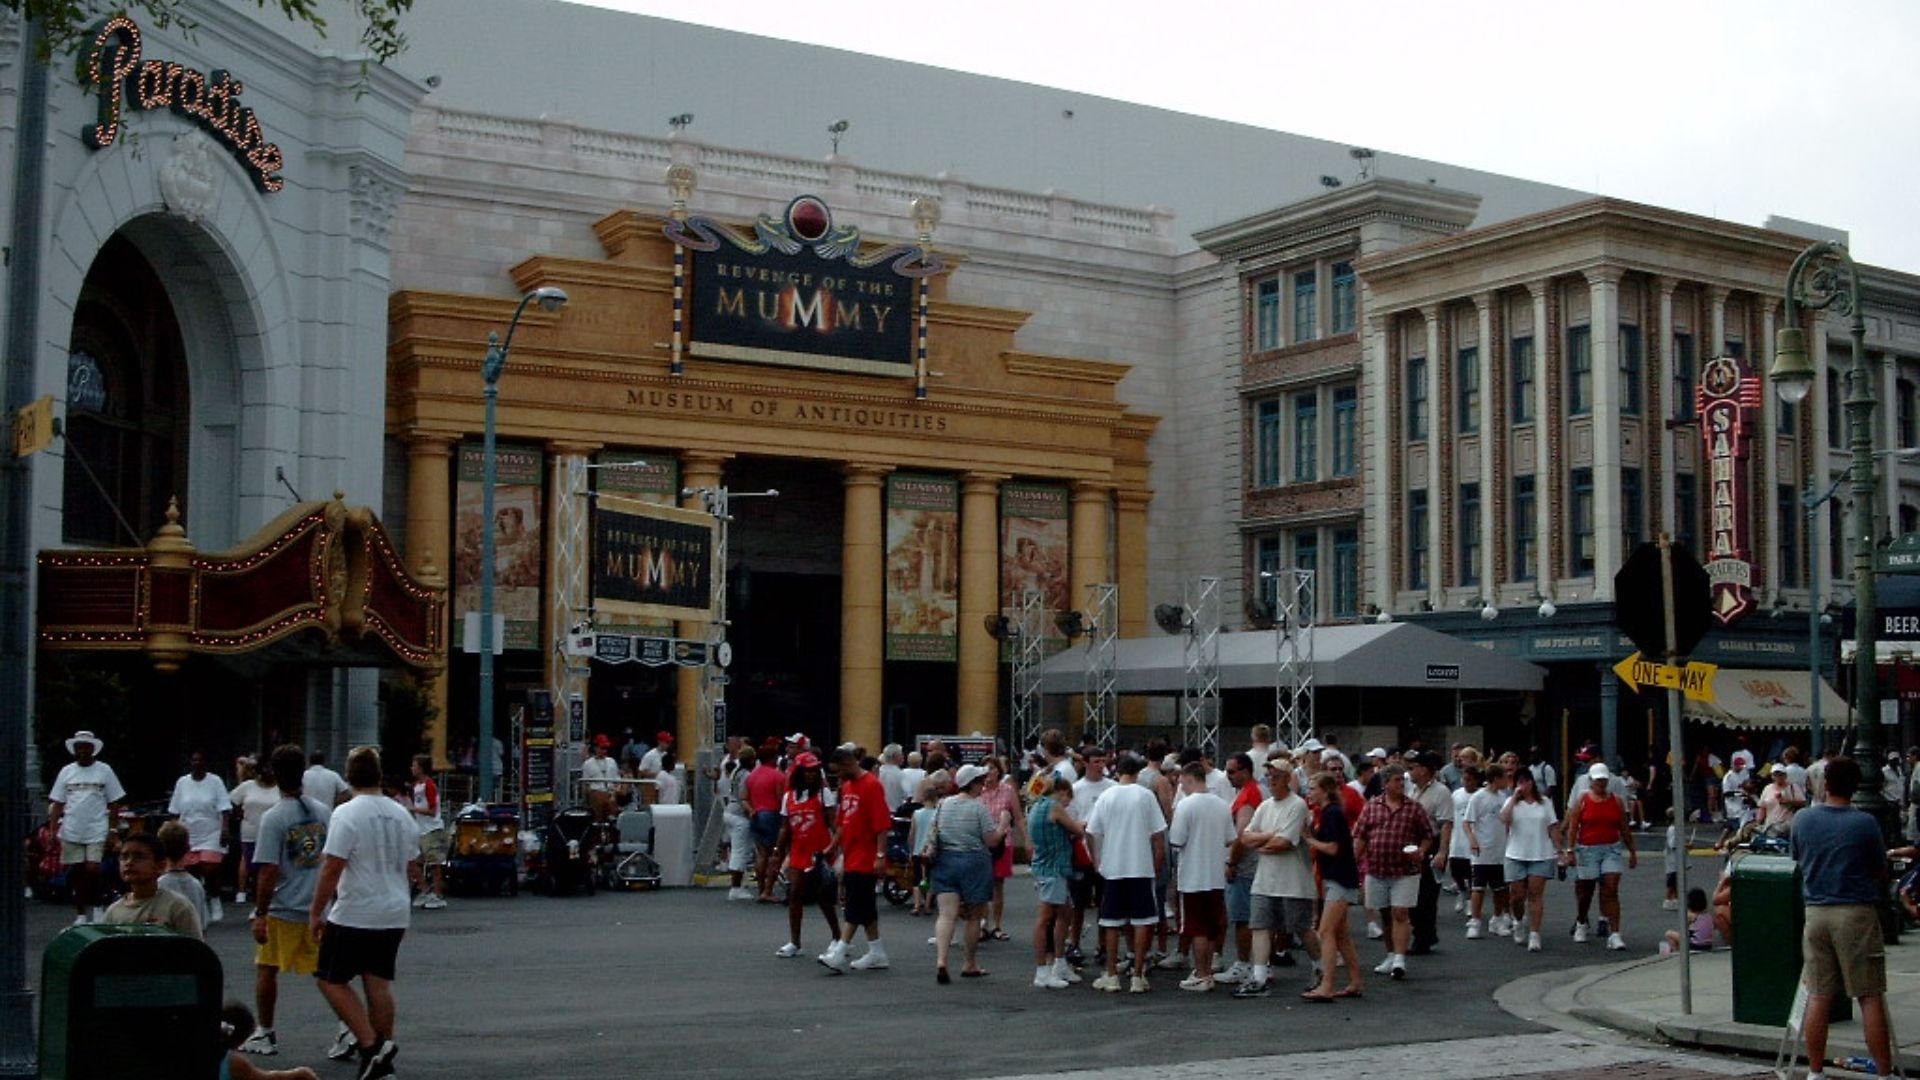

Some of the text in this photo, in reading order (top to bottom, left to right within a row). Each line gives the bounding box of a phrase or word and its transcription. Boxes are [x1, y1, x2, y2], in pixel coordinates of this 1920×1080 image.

[83, 15, 285, 193] Paradise
[717, 263, 894, 296] REVENGE OF THE
[717, 286, 893, 333] MUMMY
[627, 389, 947, 432] MUSEUM OF ANTIQUITIES
[606, 549, 701, 590] MUMMY
[1889, 554, 1914, 565] PARK
[1632, 661, 1661, 685] ONE
[1678, 667, 1707, 693] WAY
